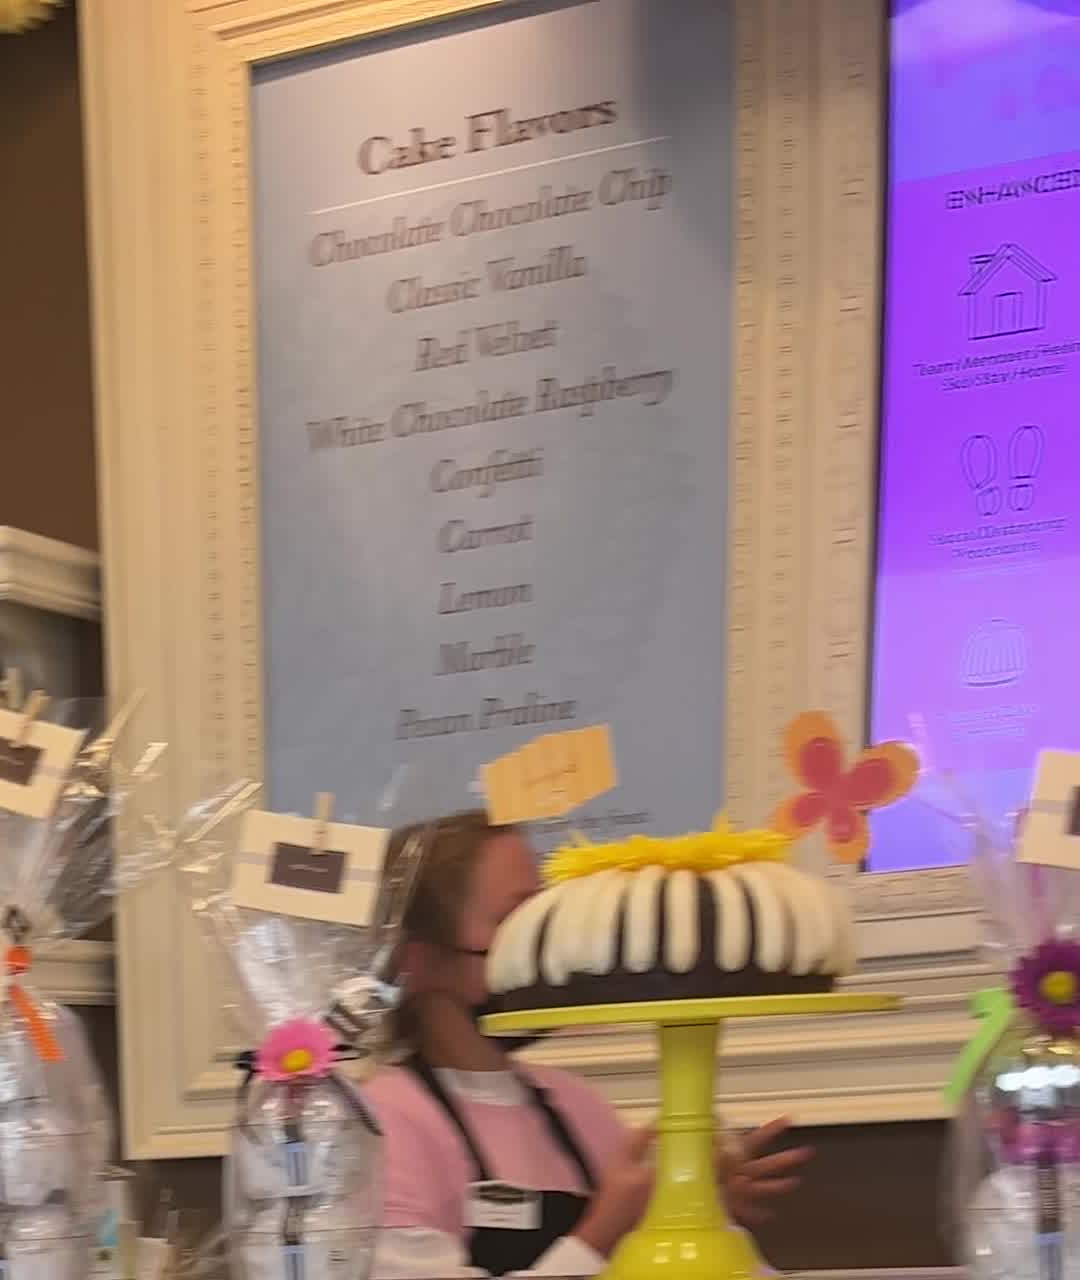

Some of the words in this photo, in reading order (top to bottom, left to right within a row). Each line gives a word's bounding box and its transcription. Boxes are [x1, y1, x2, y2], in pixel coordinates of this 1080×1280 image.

[358, 126, 456, 176] Cake
[464, 100, 618, 154] Flavors
[310, 216, 445, 267] Chocolate
[450, 184, 593, 236] Chocolate
[599, 168, 672, 211] Chip
[386, 272, 481, 314] Classic
[484, 244, 587, 291] Vanilla
[412, 330, 469, 372] Red
[472, 319, 559, 356] Velvet
[306, 416, 385, 449] White
[390, 389, 529, 438] Chocolate
[533, 365, 678, 418] Raspberry
[429, 448, 545, 498] Confetti
[435, 514, 536, 554] Carrot
[434, 581, 535, 616] Lemon
[432, 632, 536, 677] Marble
[393, 707, 474, 741] Pecan
[479, 692, 579, 730] Praline
